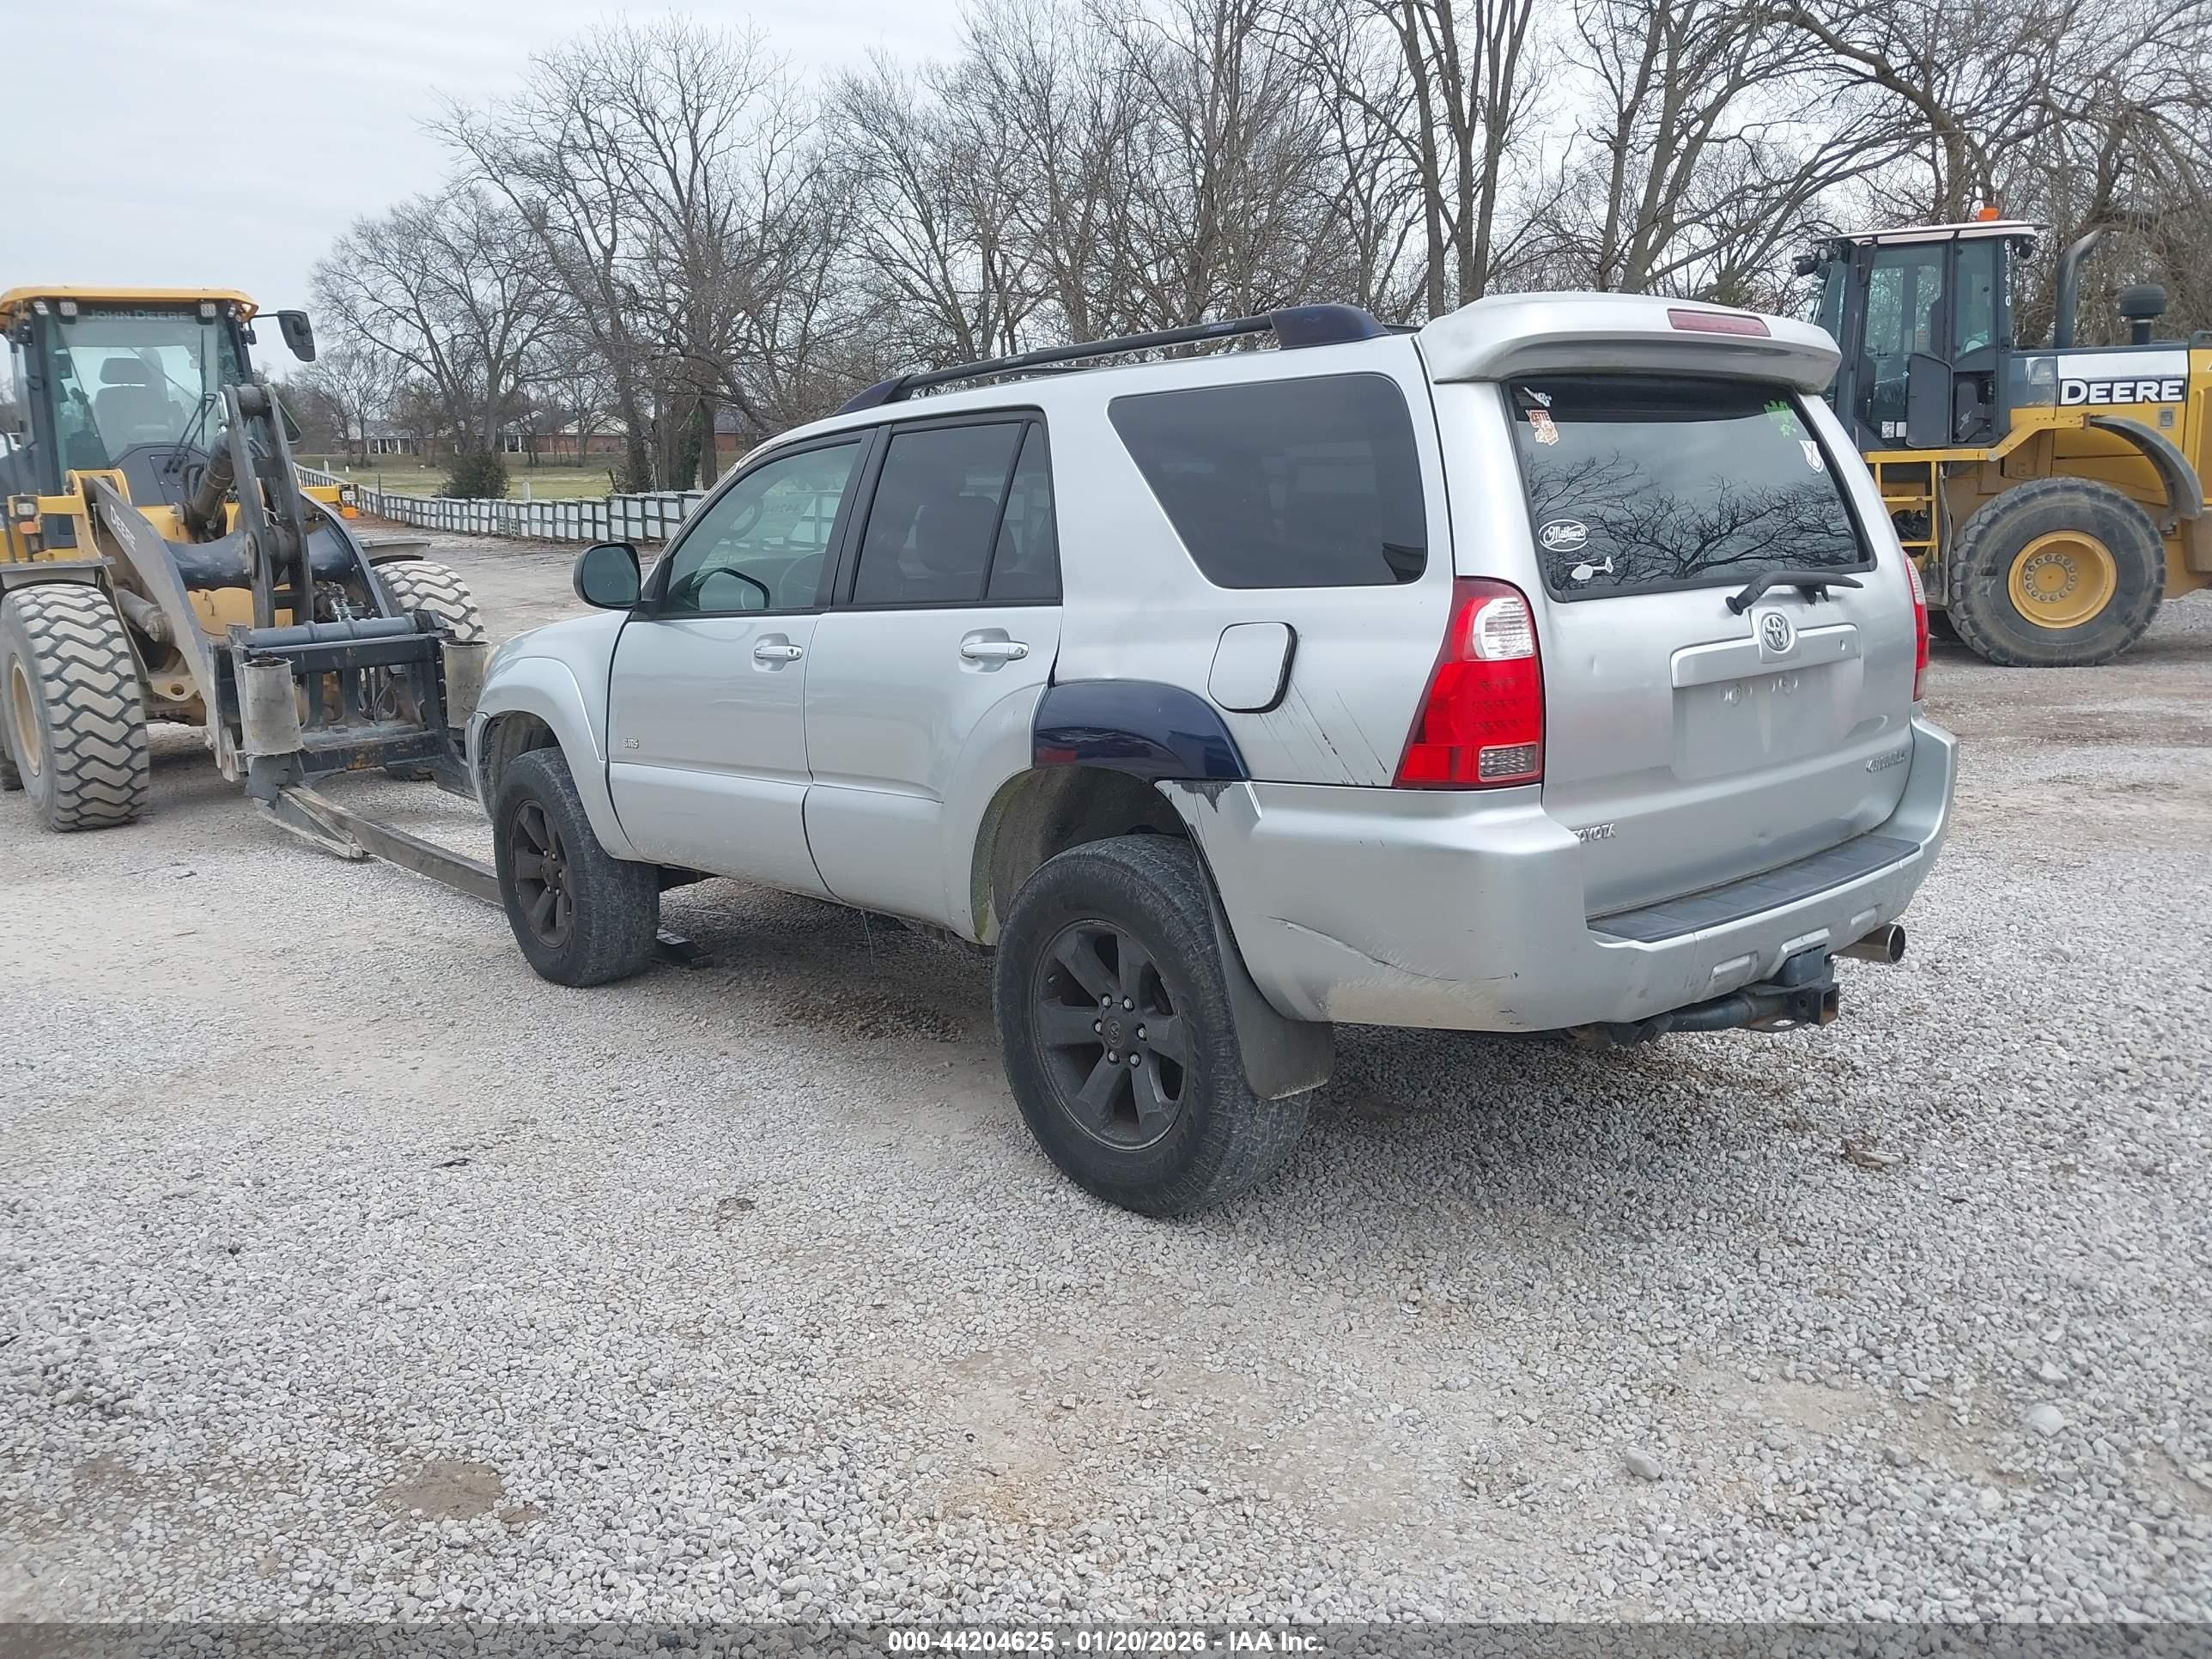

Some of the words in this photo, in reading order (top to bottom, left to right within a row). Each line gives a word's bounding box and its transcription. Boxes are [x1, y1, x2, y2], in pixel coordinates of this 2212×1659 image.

[88, 309, 131, 320] JOHN
[134, 309, 189, 321] DEERE
[2060, 379, 2185, 406] DEERE
[109, 503, 137, 552] DEERE
